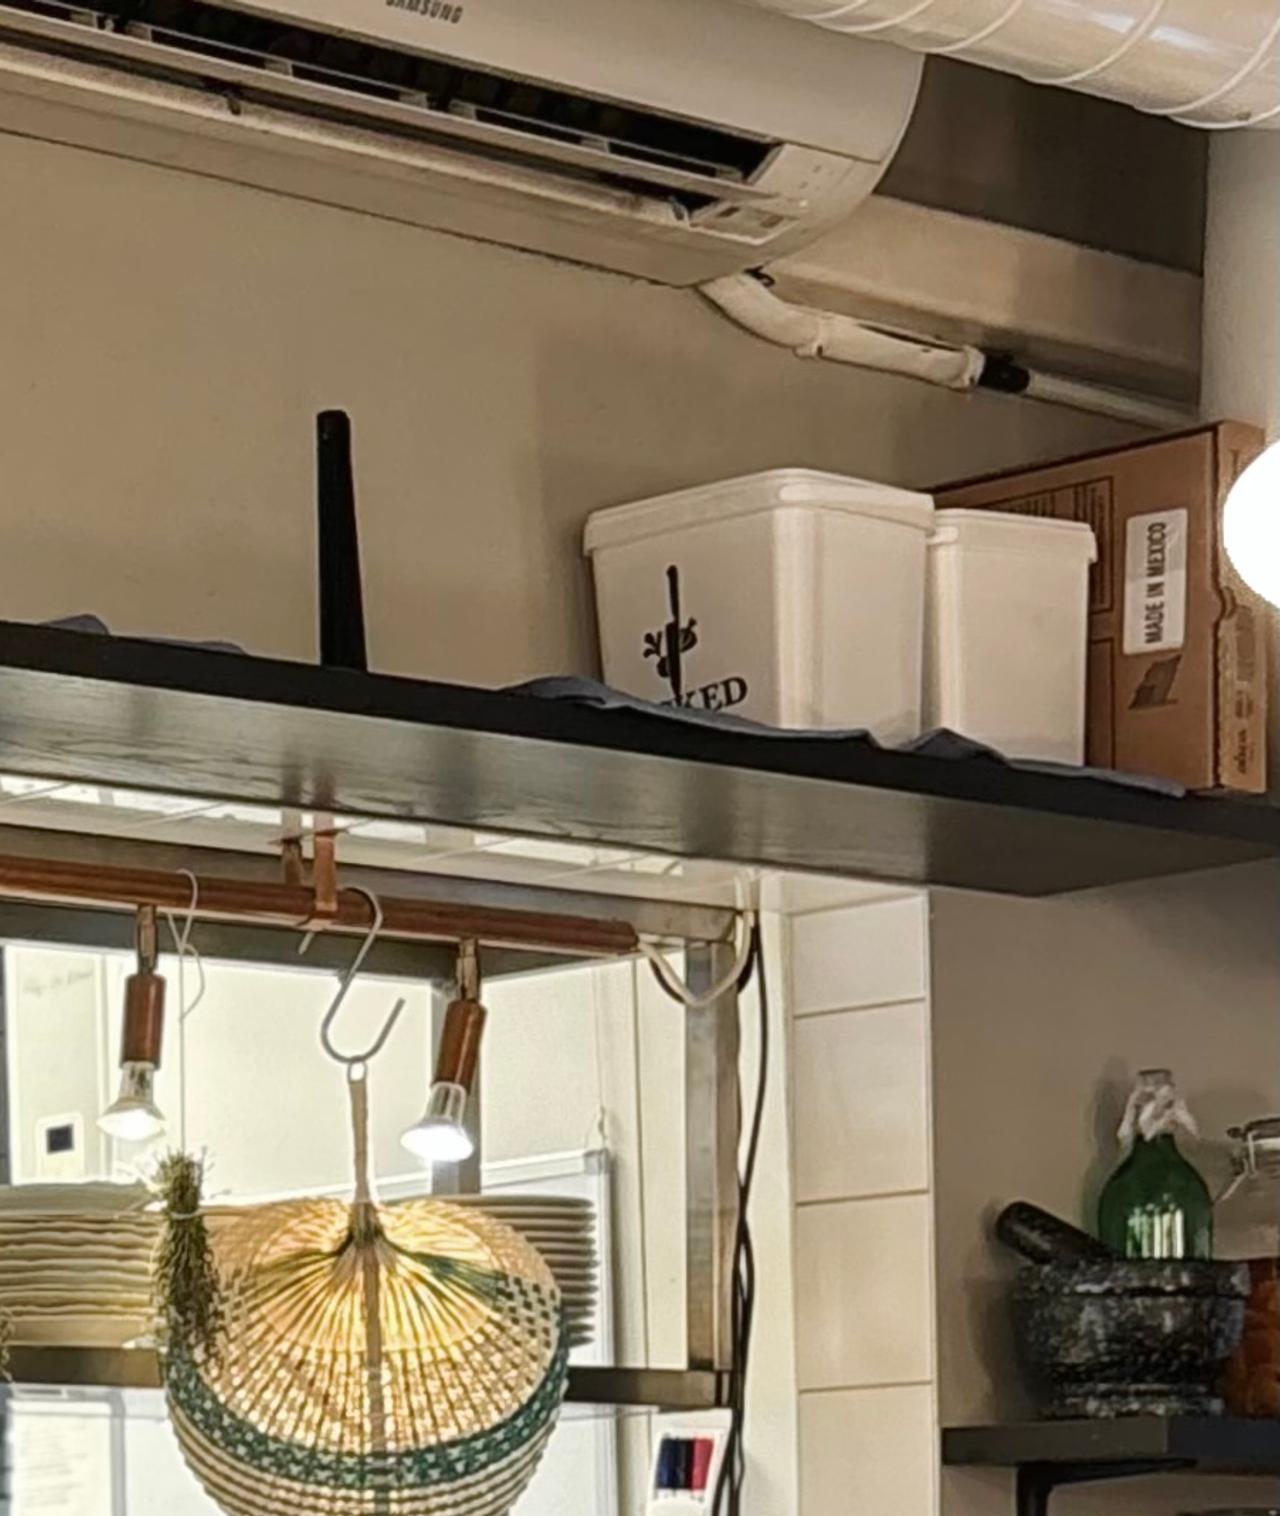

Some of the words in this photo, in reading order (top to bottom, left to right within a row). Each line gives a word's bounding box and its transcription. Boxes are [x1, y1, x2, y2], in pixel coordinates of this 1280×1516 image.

[1147, 522, 1166, 577] MEXICO
[1146, 581, 1165, 598] IN
[1145, 602, 1164, 644] MADE
